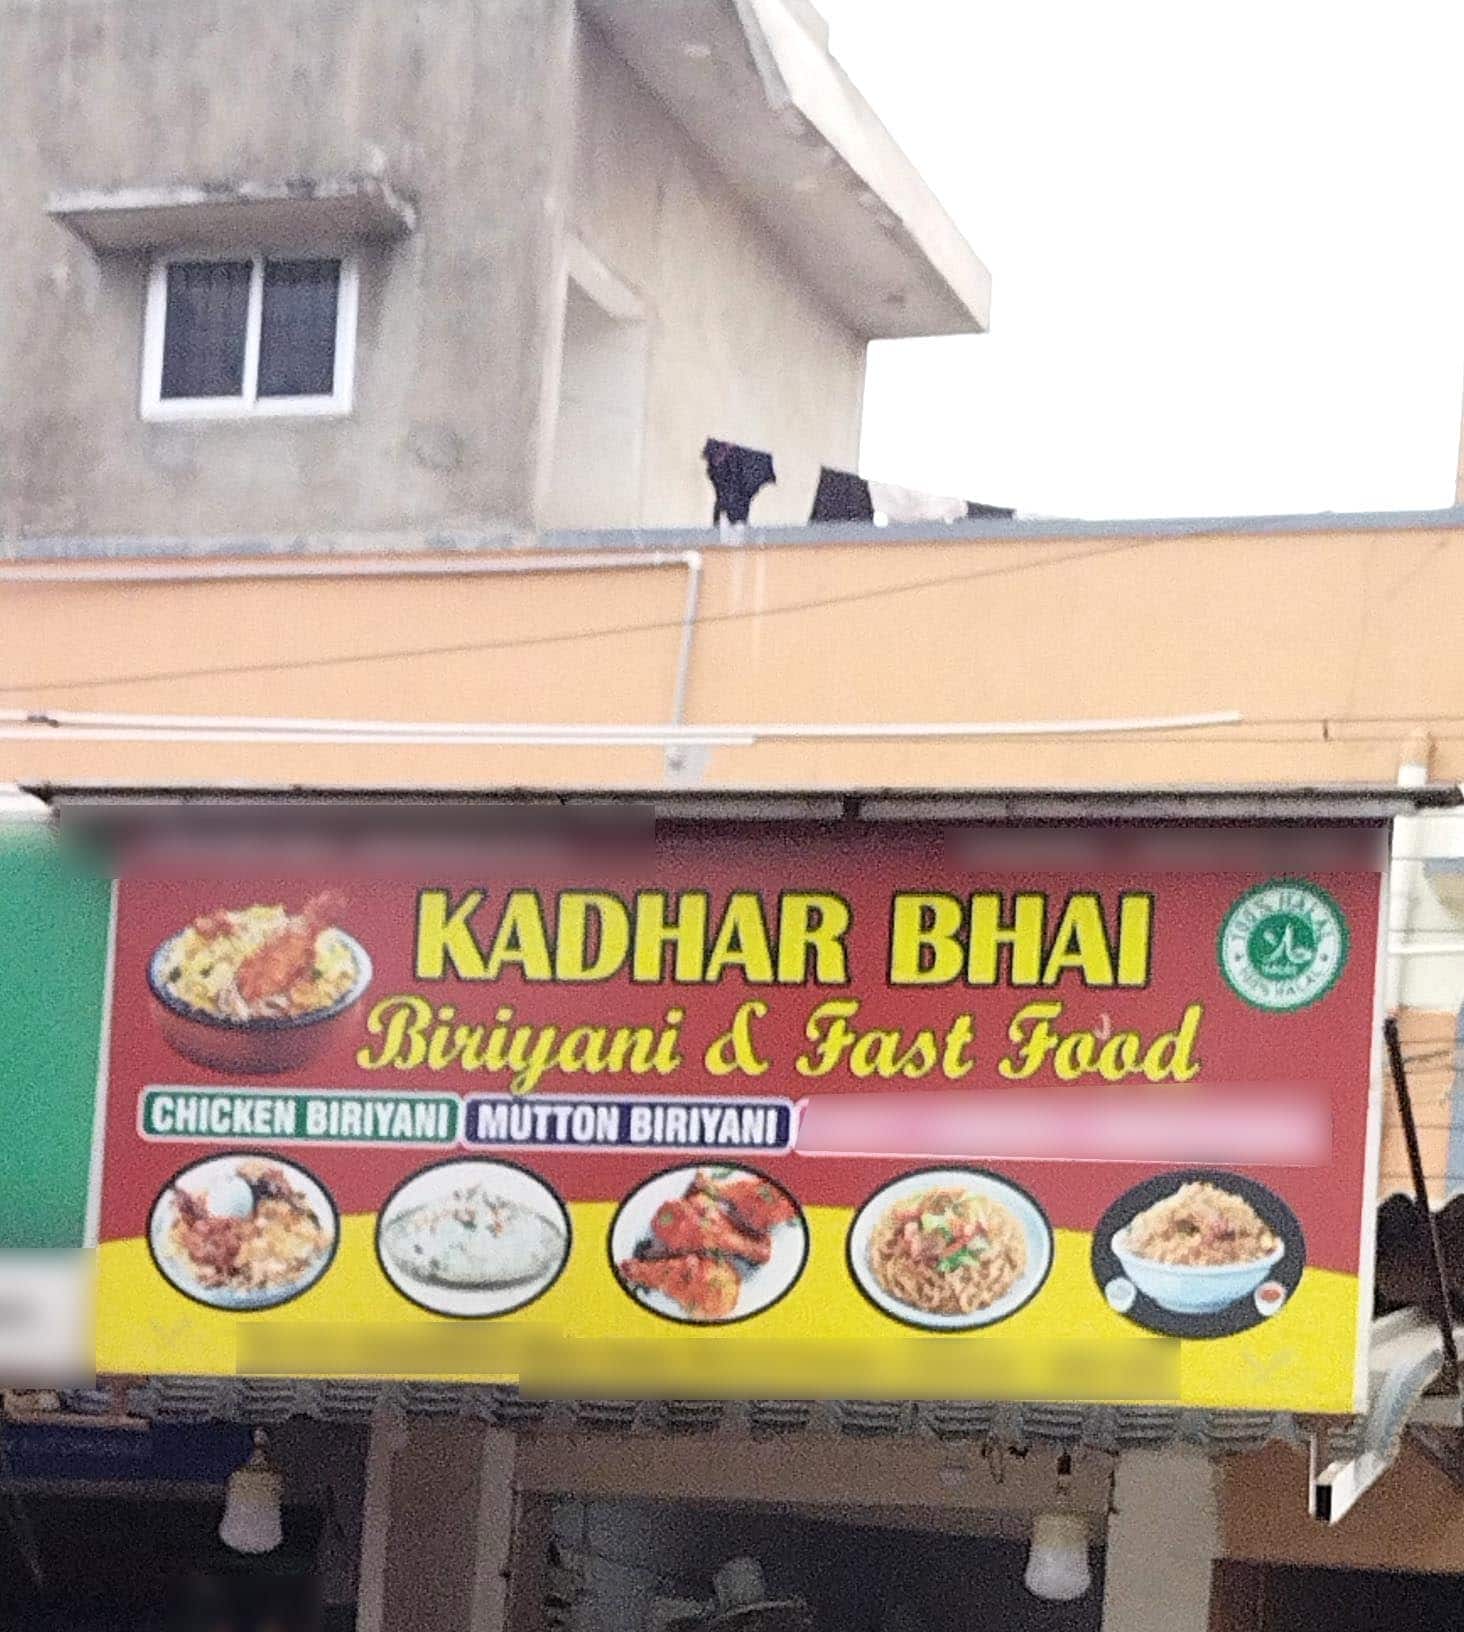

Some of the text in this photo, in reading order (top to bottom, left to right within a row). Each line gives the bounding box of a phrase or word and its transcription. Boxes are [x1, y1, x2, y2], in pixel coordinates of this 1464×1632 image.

[414, 888, 1154, 989] KADHAR BHAI
[358, 994, 1204, 1094] Biriyani & Fast Food
[151, 1095, 450, 1139] CHICKEN BIRIYANI
[476, 1102, 620, 1143] MUTTON
[629, 1105, 779, 1146] BIRIYANI
